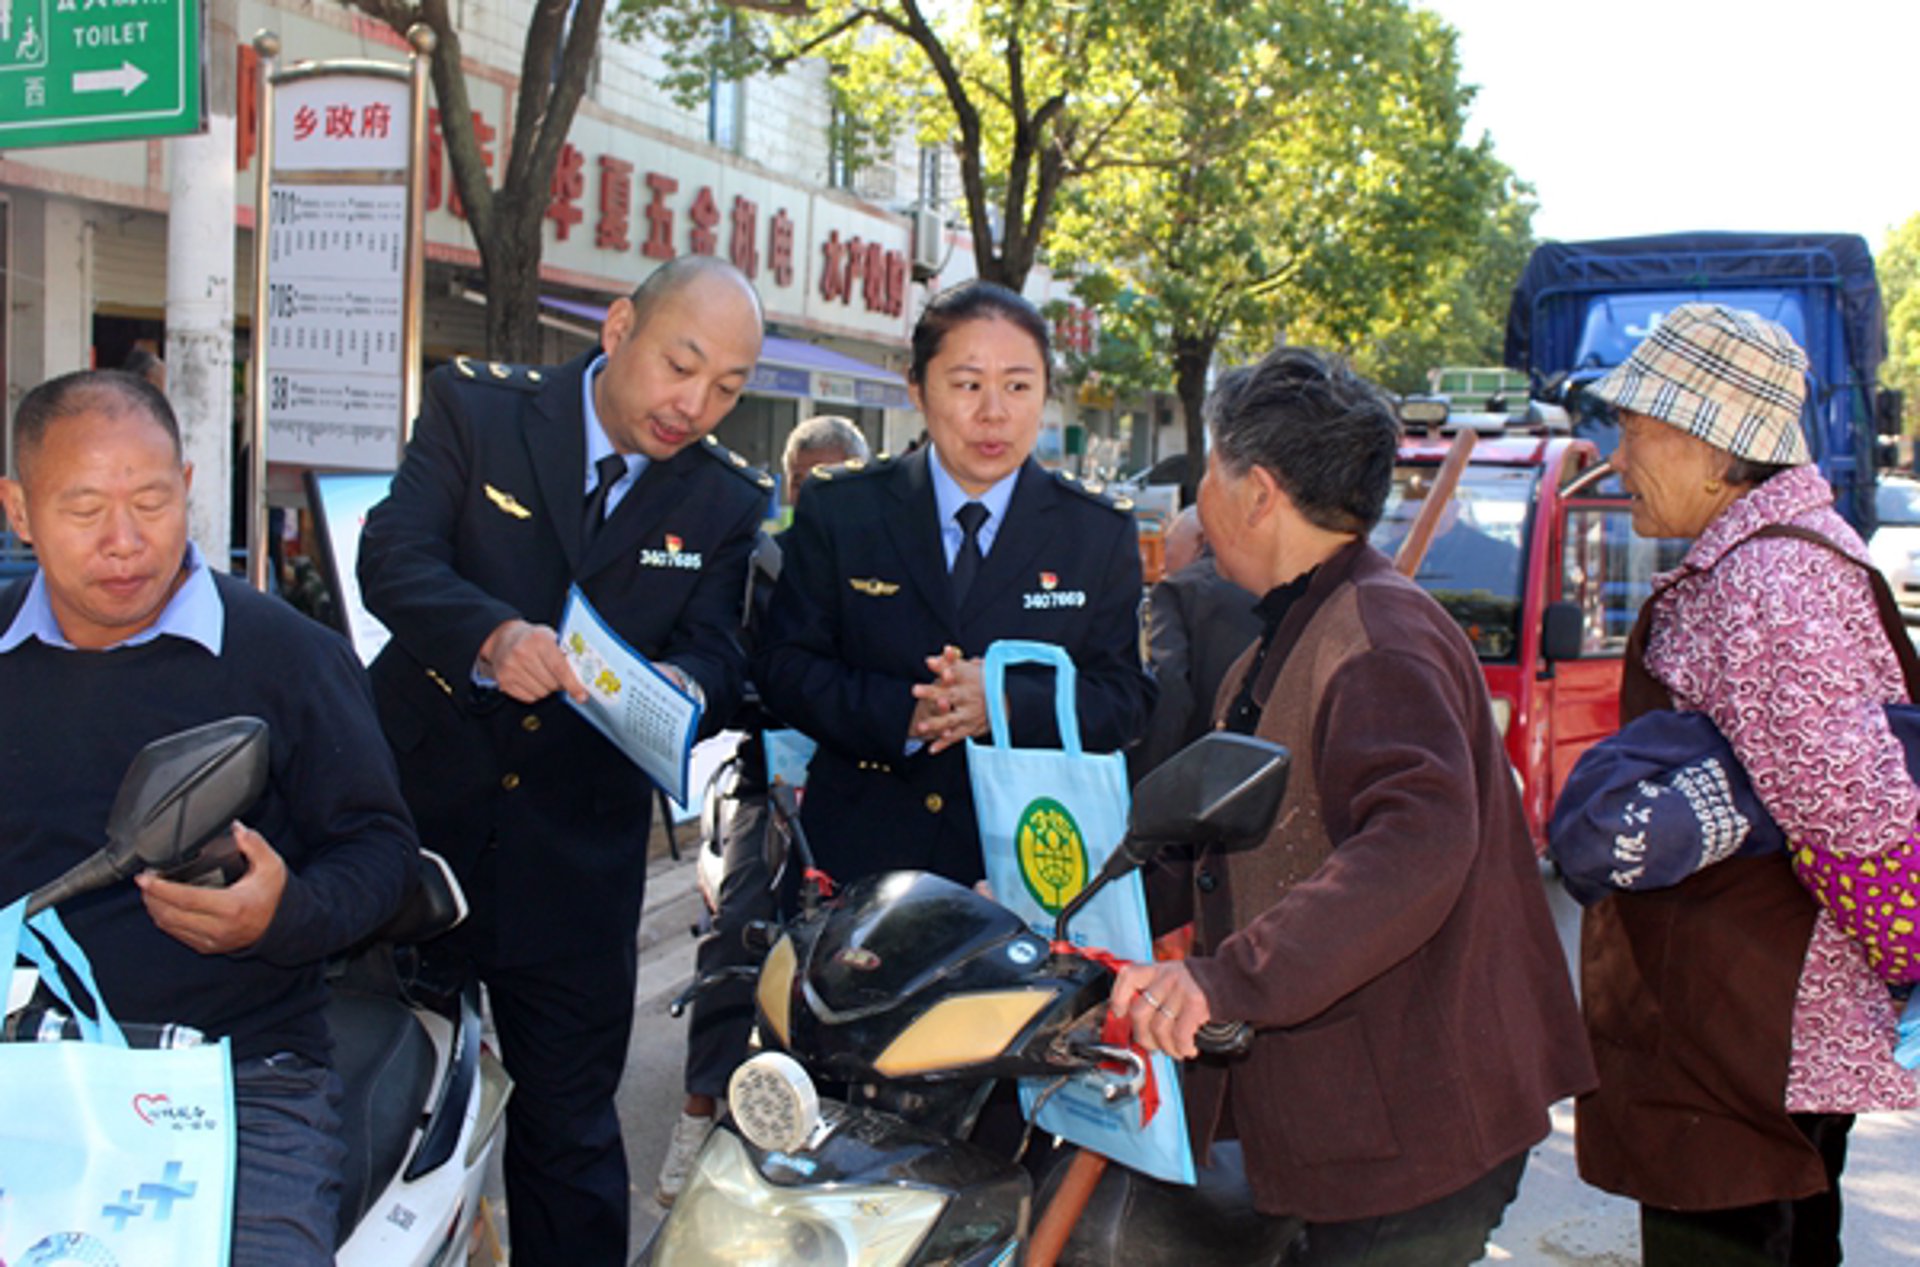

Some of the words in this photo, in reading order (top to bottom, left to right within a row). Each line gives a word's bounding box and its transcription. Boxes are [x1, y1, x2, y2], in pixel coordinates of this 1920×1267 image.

[73, 22, 148, 48] TOILET
[25, 77, 45, 107] 西
[293, 102, 391, 140] 乡政府
[545, 143, 794, 287] 华夏五金机电
